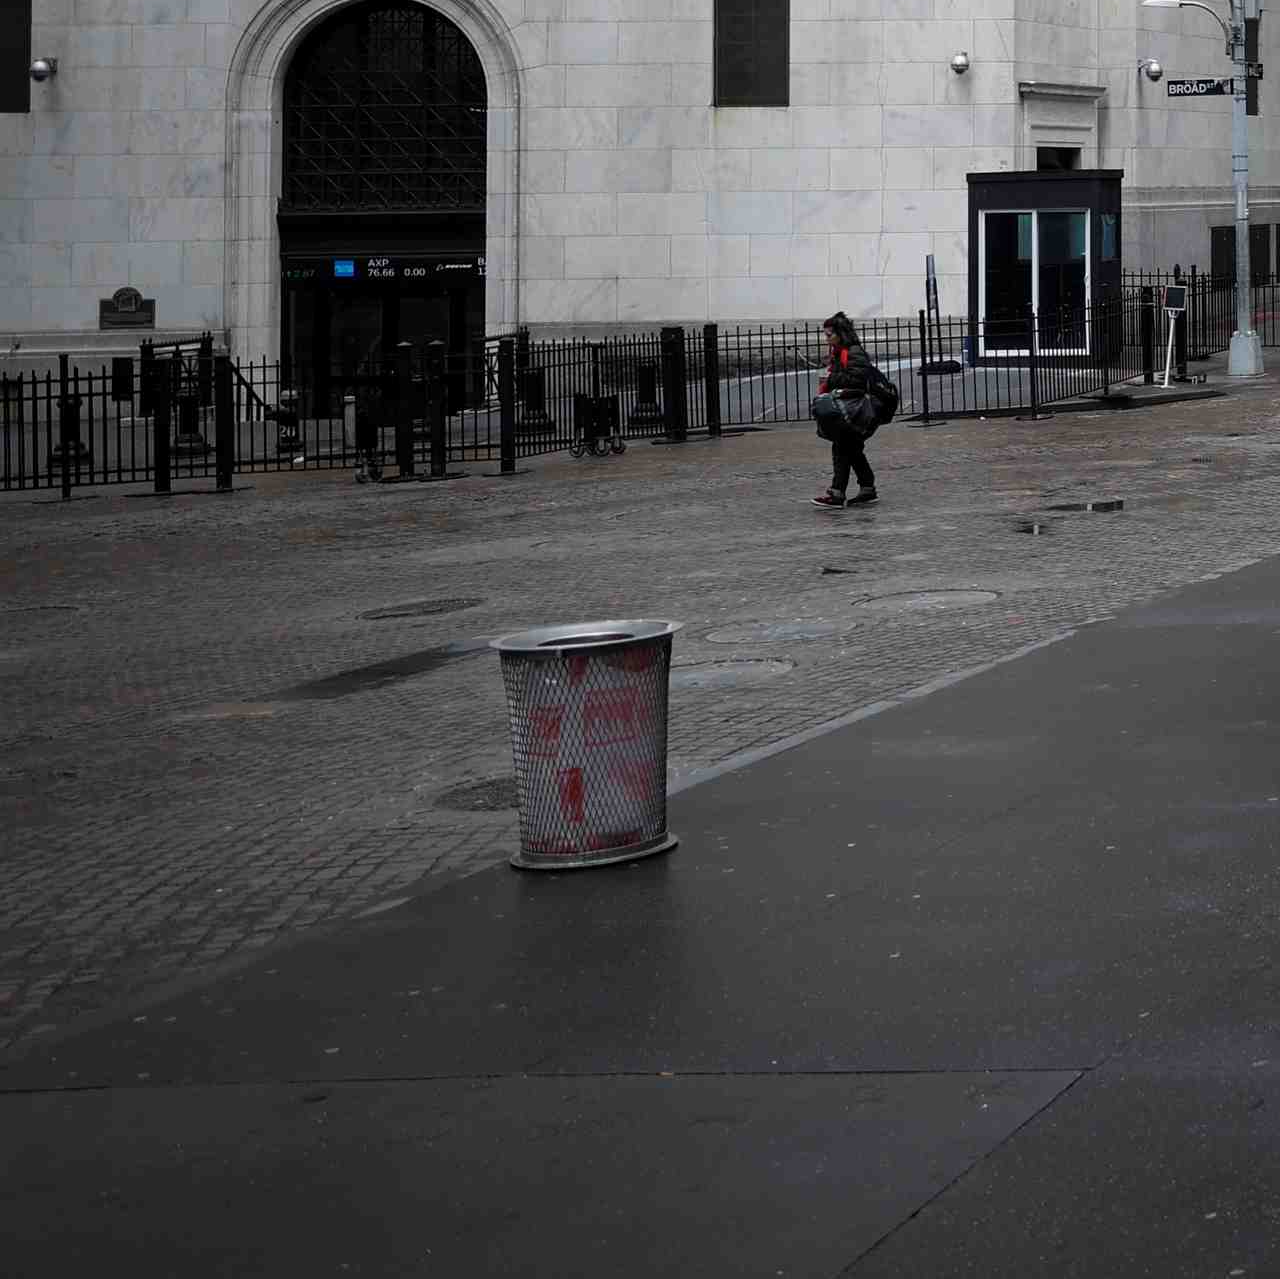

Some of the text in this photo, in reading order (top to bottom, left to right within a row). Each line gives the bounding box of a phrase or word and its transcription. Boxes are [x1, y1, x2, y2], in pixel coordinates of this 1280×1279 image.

[1169, 84, 1206, 94] BROAD
[368, 259, 389, 267] AXP
[404, 268, 426, 277] 0.00
